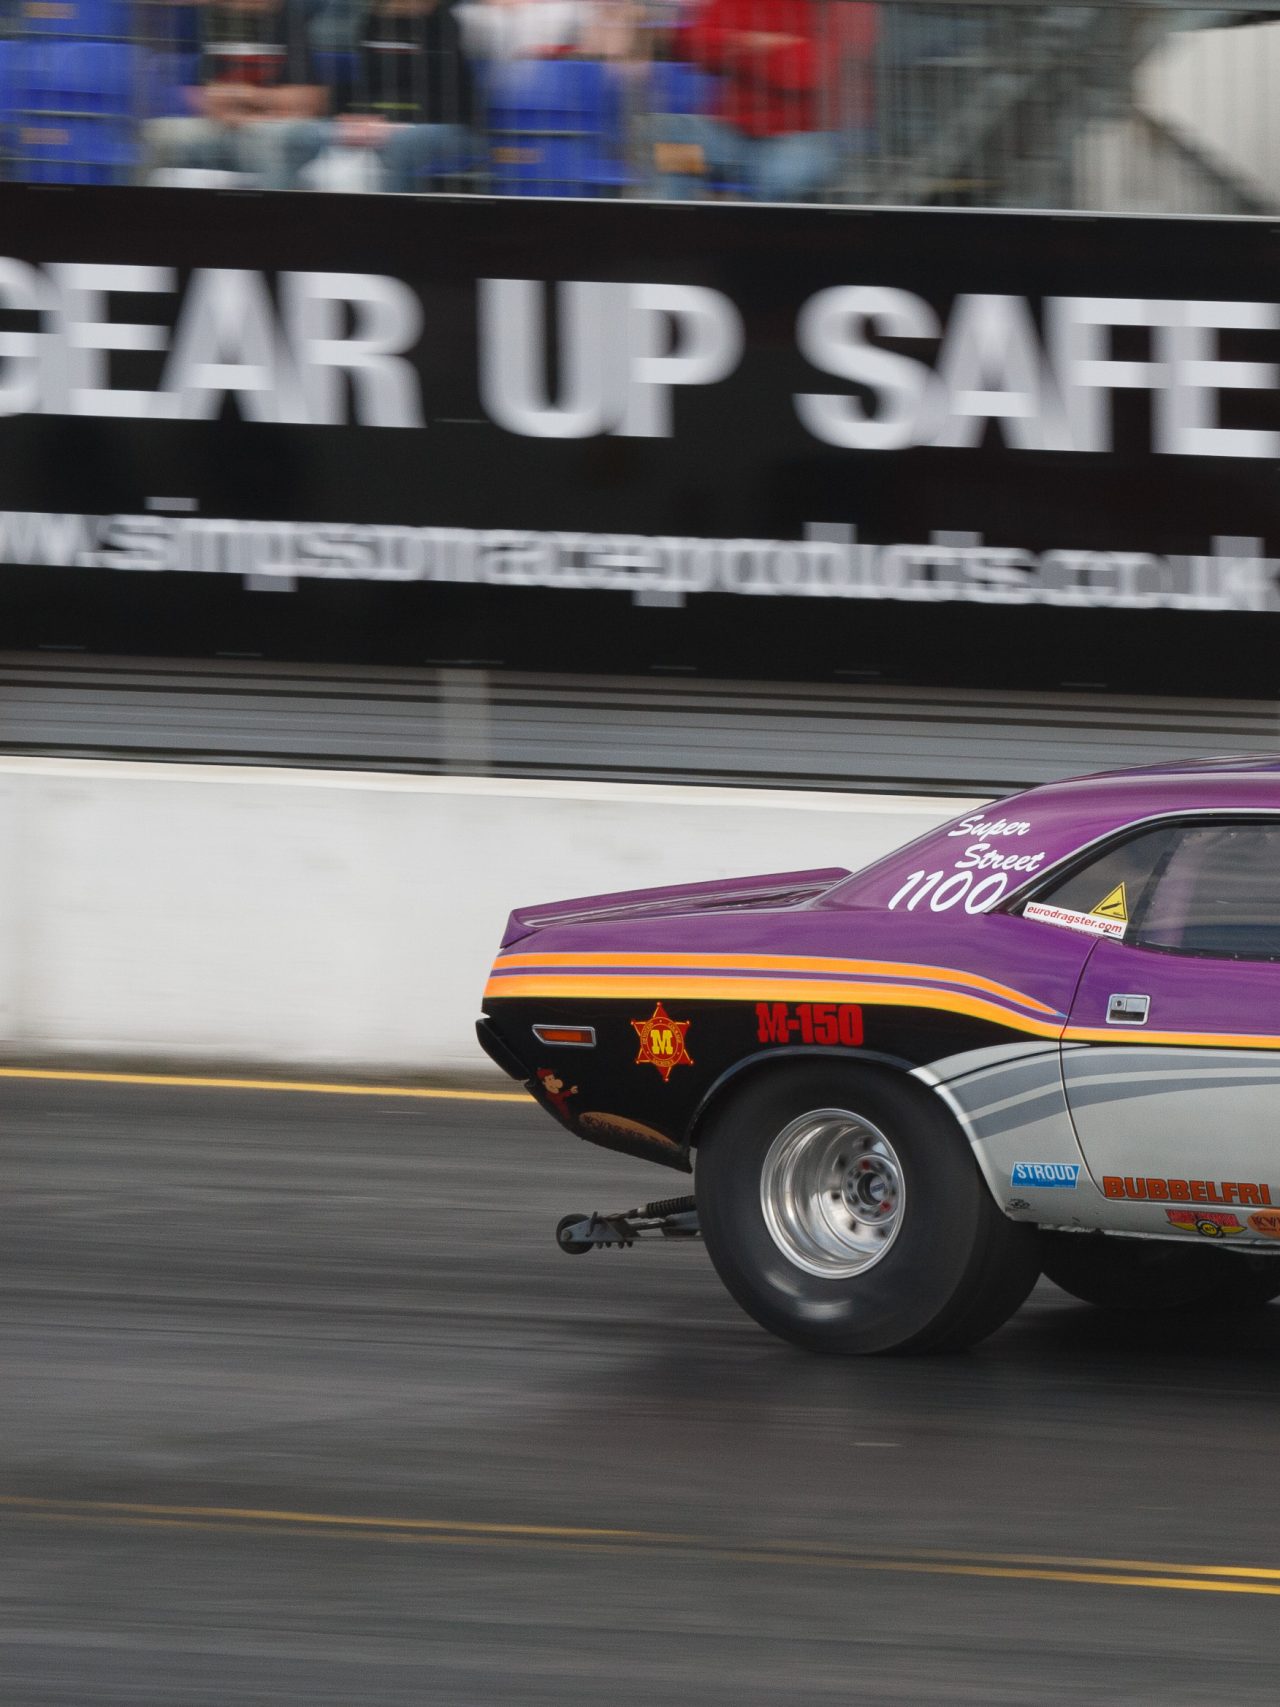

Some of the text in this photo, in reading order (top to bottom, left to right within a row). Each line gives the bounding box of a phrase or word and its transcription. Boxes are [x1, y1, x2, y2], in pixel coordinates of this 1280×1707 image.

[478, 277, 747, 439] UP
[948, 814, 1030, 842] Super
[955, 843, 1045, 872] Street
[887, 870, 1008, 914] 1100
[1026, 904, 1122, 933] eurodragster.com
[754, 1002, 864, 1046] M-150
[650, 1029, 674, 1055] M
[1016, 1164, 1076, 1181] STROUD
[1102, 1176, 1272, 1204] BUBBELFRI
